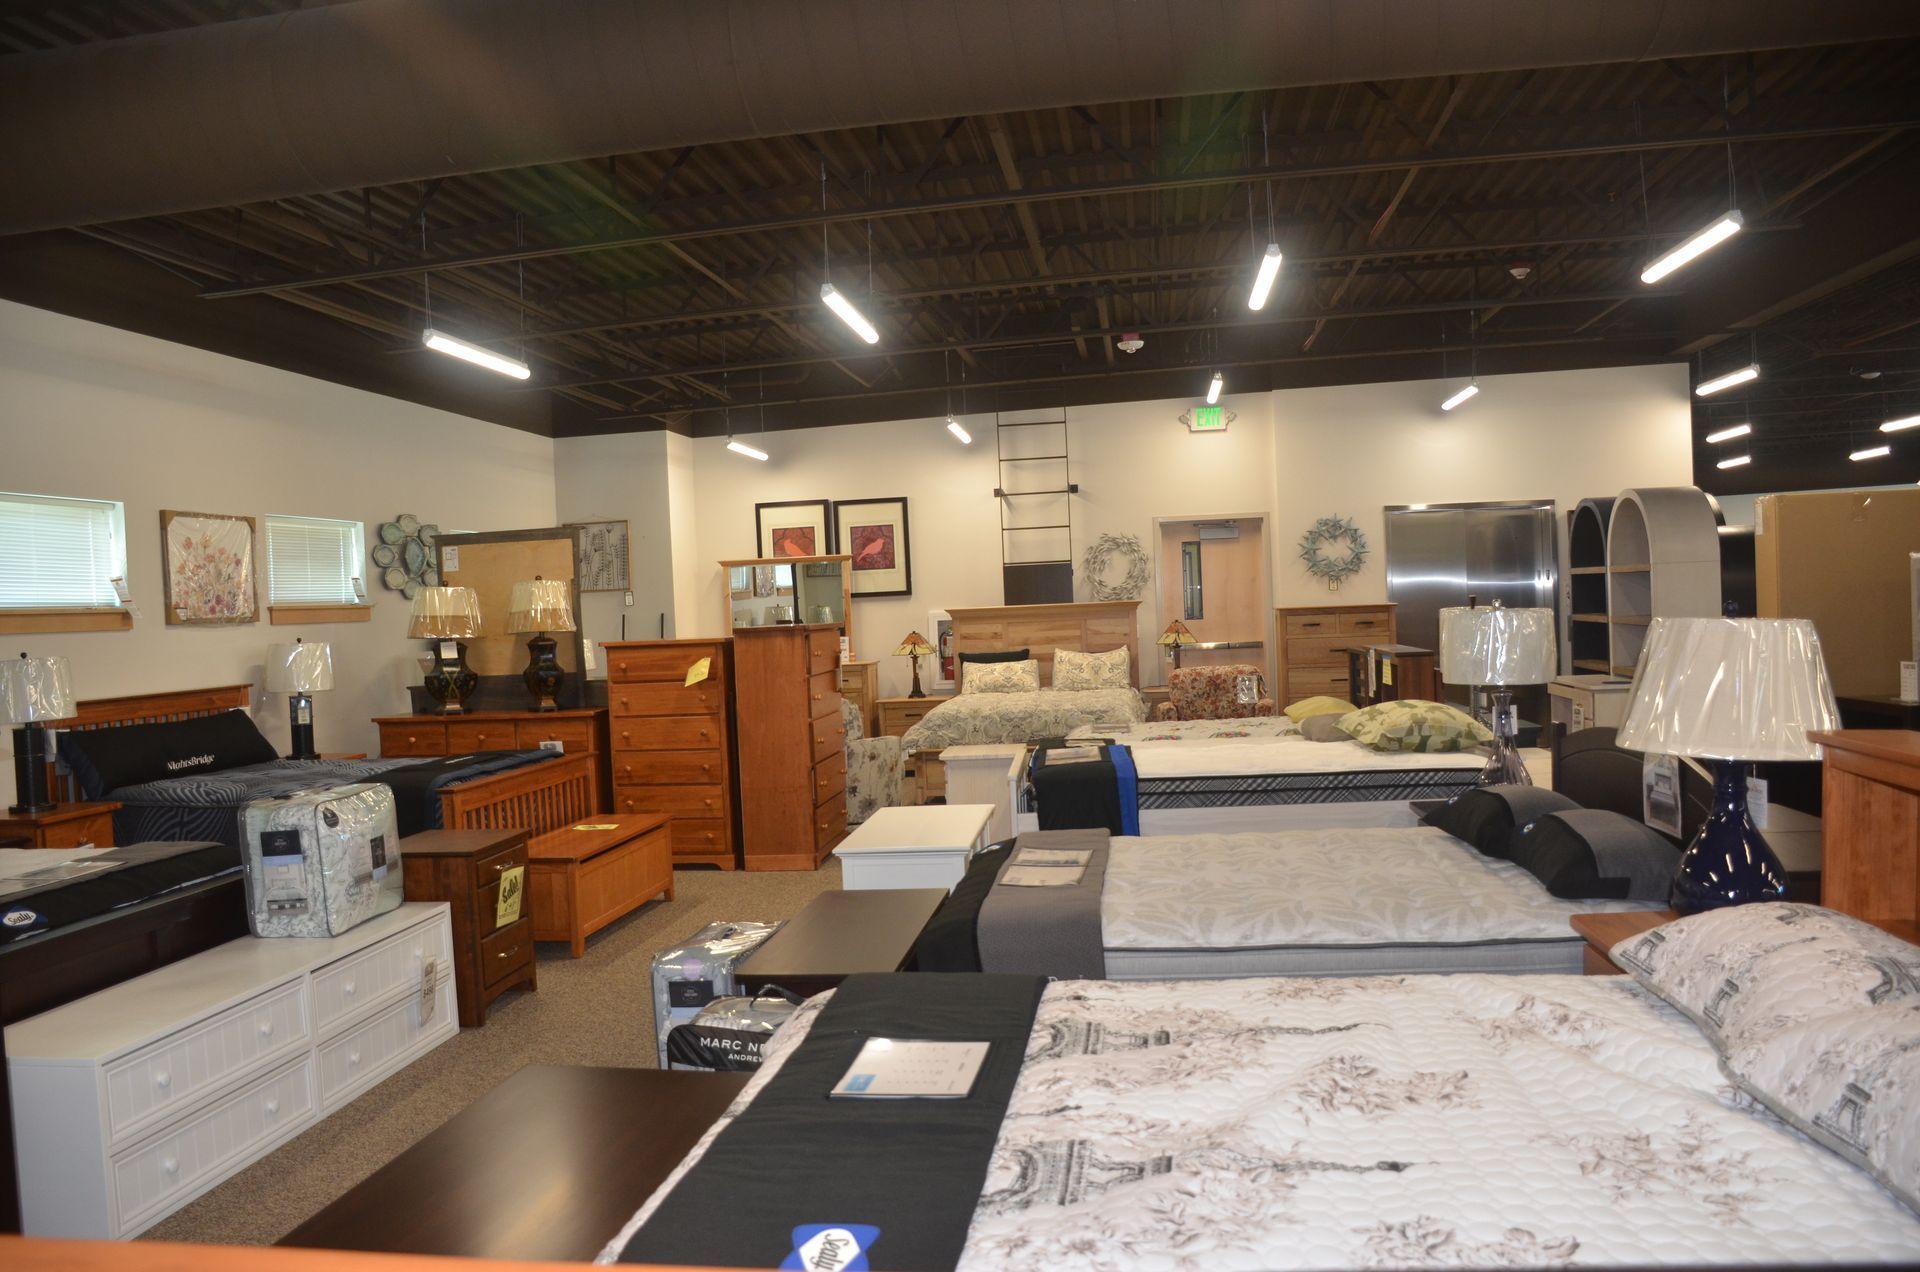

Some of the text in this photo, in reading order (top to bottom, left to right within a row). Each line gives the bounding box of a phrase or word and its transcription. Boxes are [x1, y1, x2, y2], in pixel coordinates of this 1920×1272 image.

[1196, 406, 1222, 427] EXIT
[700, 1037, 742, 1050] MARC
[808, 1233, 850, 1271] Sealy
